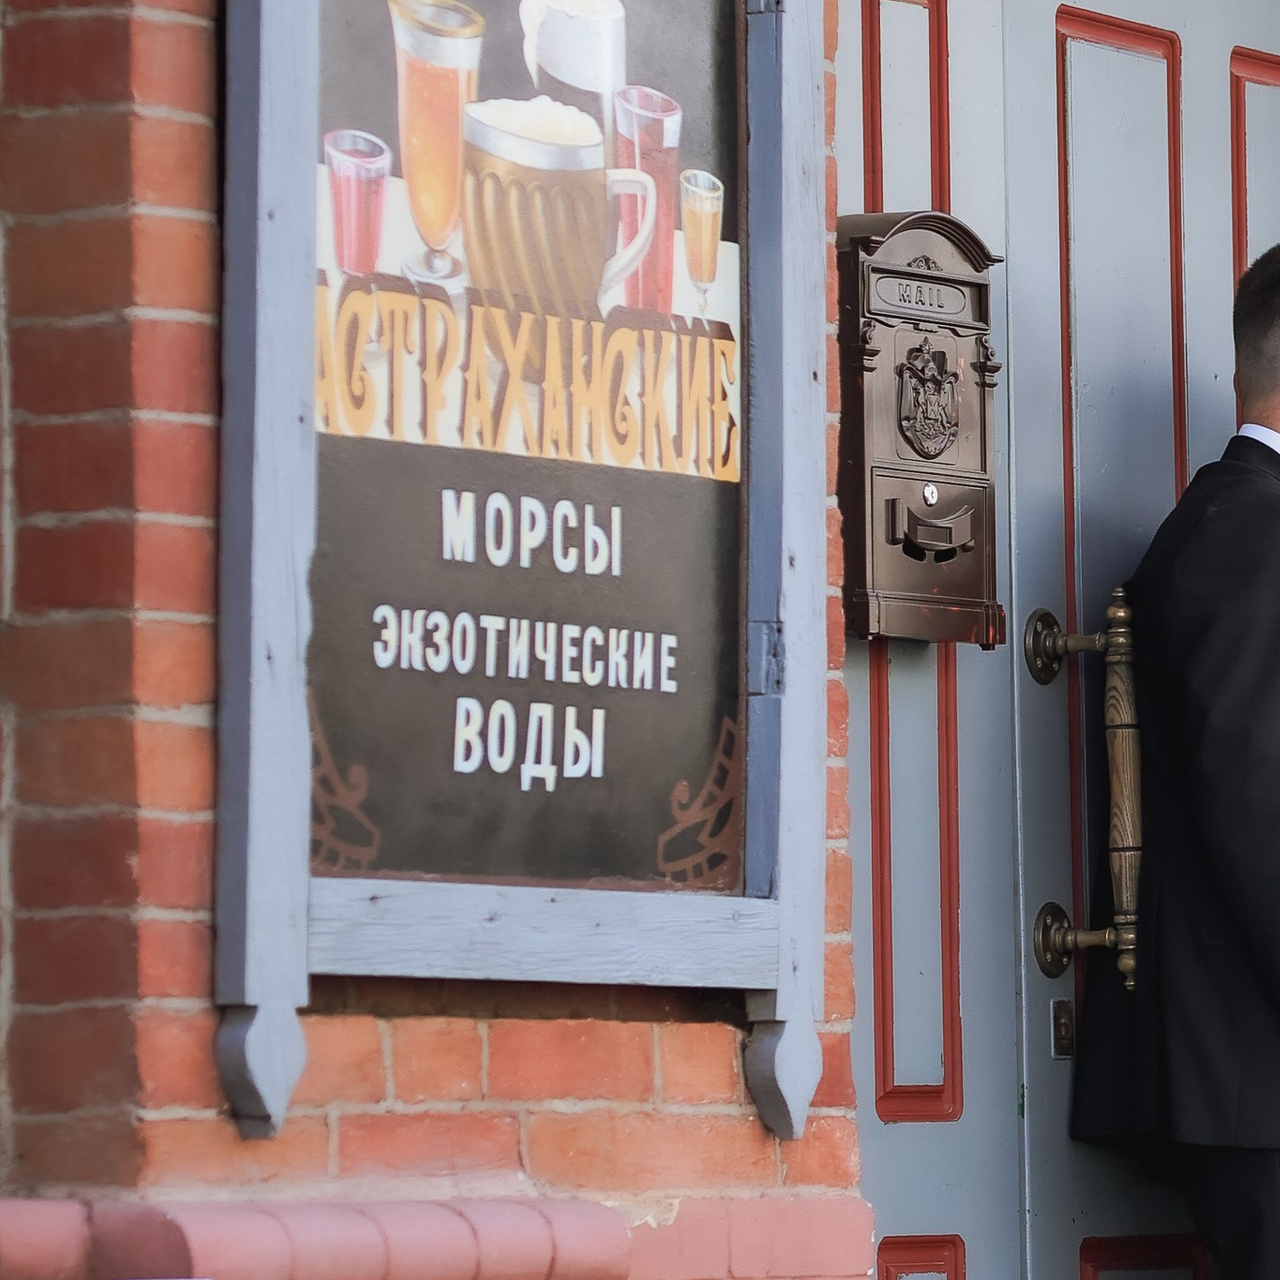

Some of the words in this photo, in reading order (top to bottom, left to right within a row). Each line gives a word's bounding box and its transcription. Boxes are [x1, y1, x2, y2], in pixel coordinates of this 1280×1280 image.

[898, 282, 945, 309] MAIL
[316, 278, 740, 482] АСТРАХАНСКИЕ
[441, 488, 622, 576] МОРСЫ
[372, 604, 679, 693] ЭКЗОТИЧЕСКИЕ
[453, 696, 607, 792] ВОДЫ
